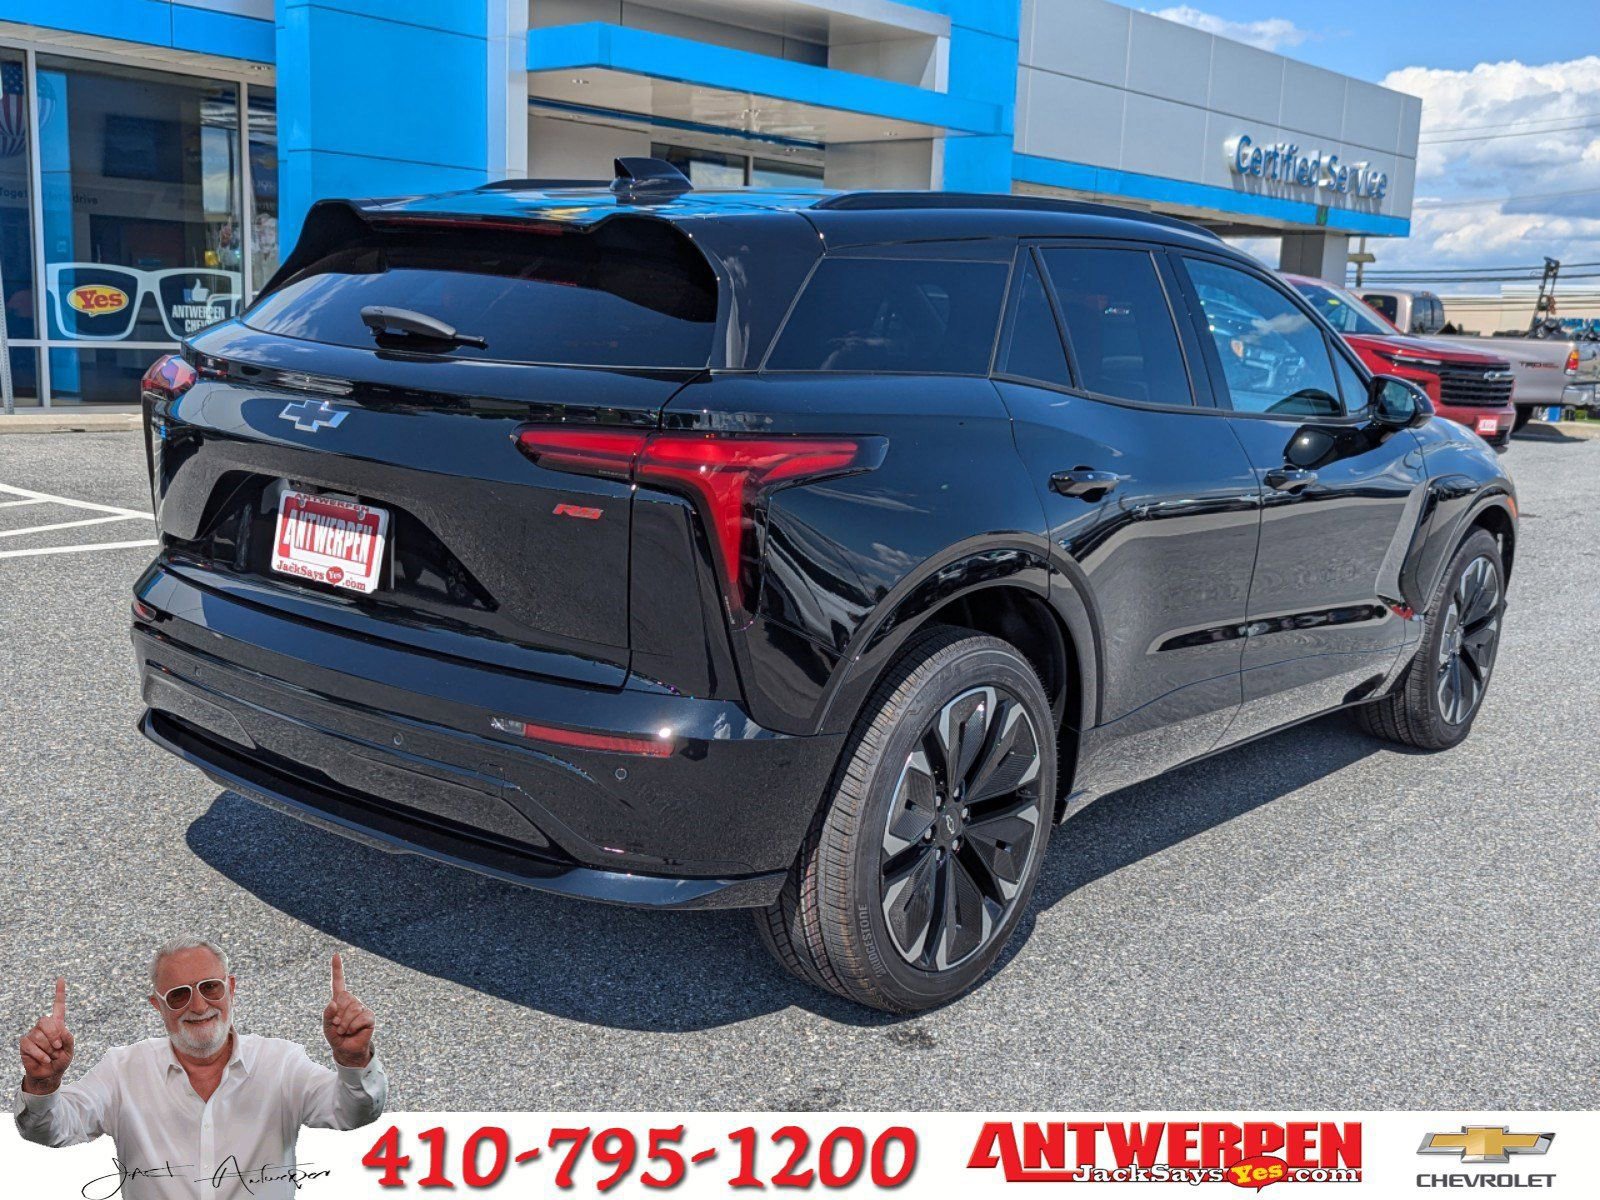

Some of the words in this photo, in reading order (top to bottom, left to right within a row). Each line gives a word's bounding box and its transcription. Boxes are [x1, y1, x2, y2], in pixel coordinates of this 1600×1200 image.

[1226, 134, 1321, 188] Certified
[76, 290, 123, 309] Yes
[172, 304, 226, 320] ANTWERPEN
[294, 493, 370, 512] ANTWERPEN
[552, 503, 604, 520] RS
[282, 508, 373, 565] ANTWERPEN
[858, 903, 887, 978] BRIDGESTONE
